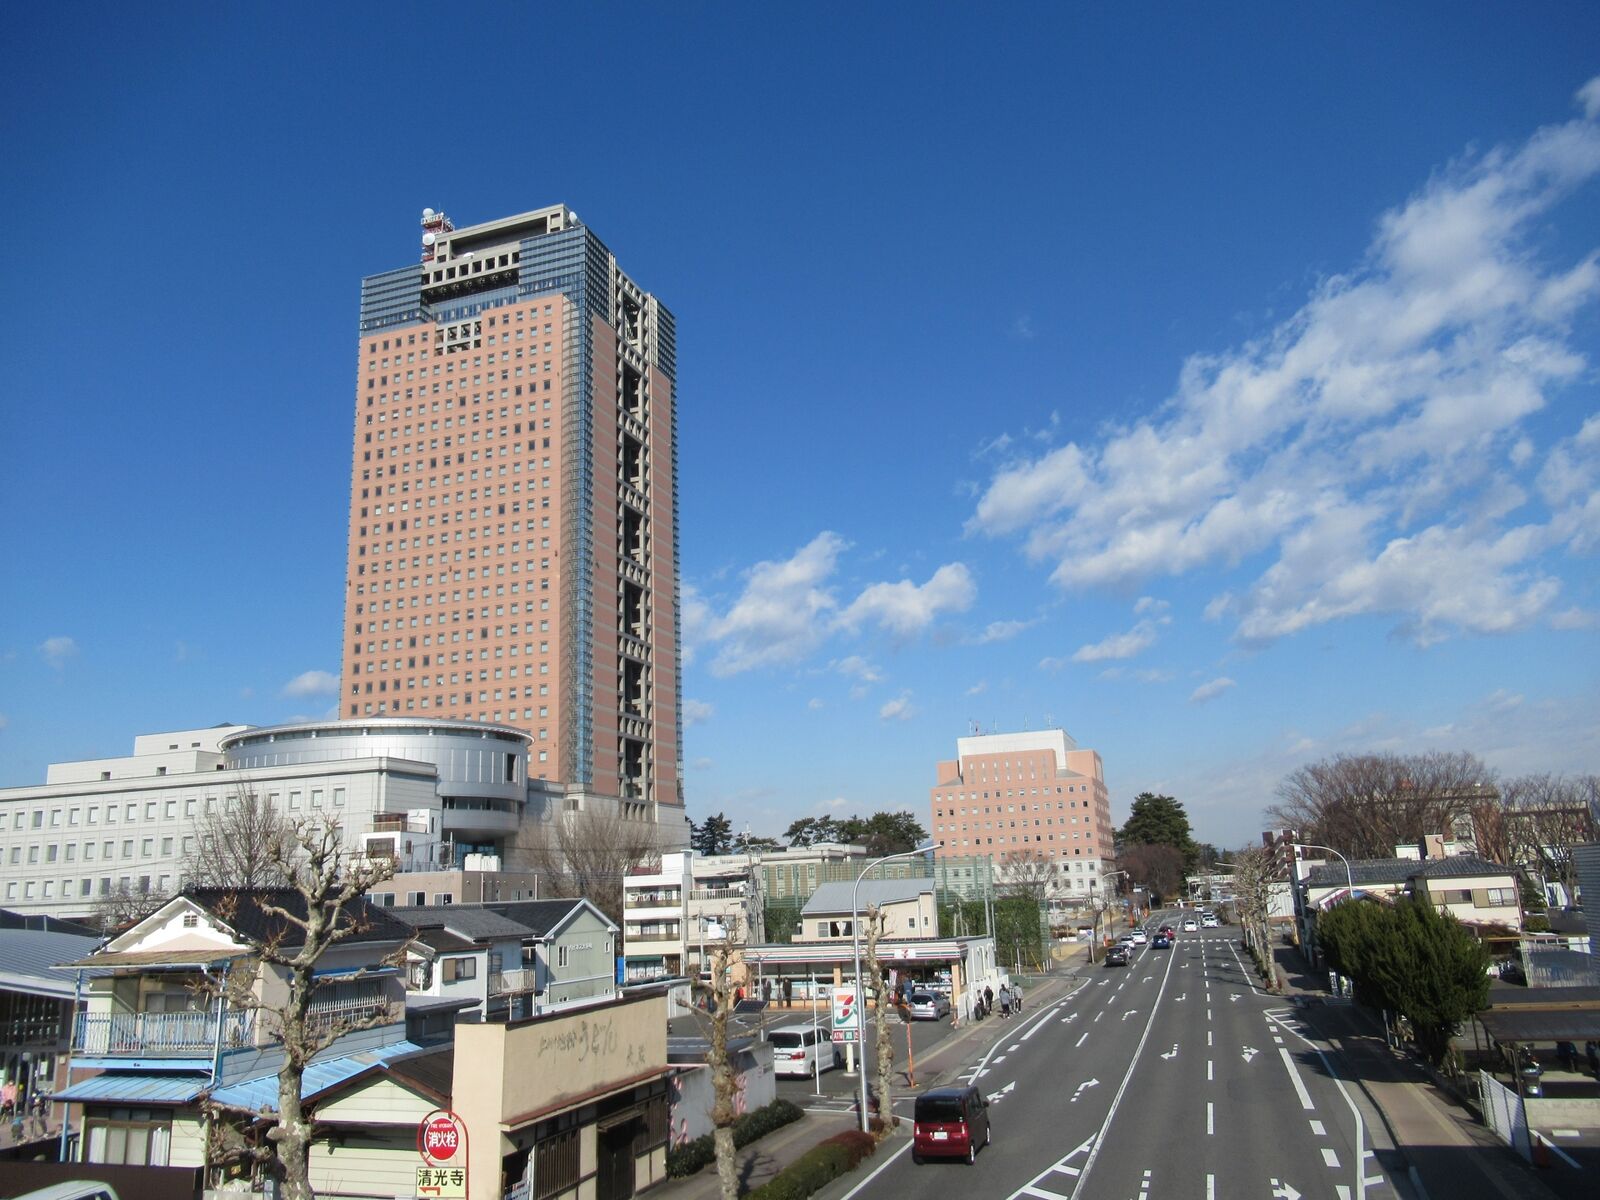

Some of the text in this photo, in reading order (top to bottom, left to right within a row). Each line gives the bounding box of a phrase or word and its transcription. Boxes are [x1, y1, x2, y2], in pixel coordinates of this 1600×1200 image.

[428, 1130, 457, 1148] 消火栓
[418, 1169, 464, 1187] 清光寺
